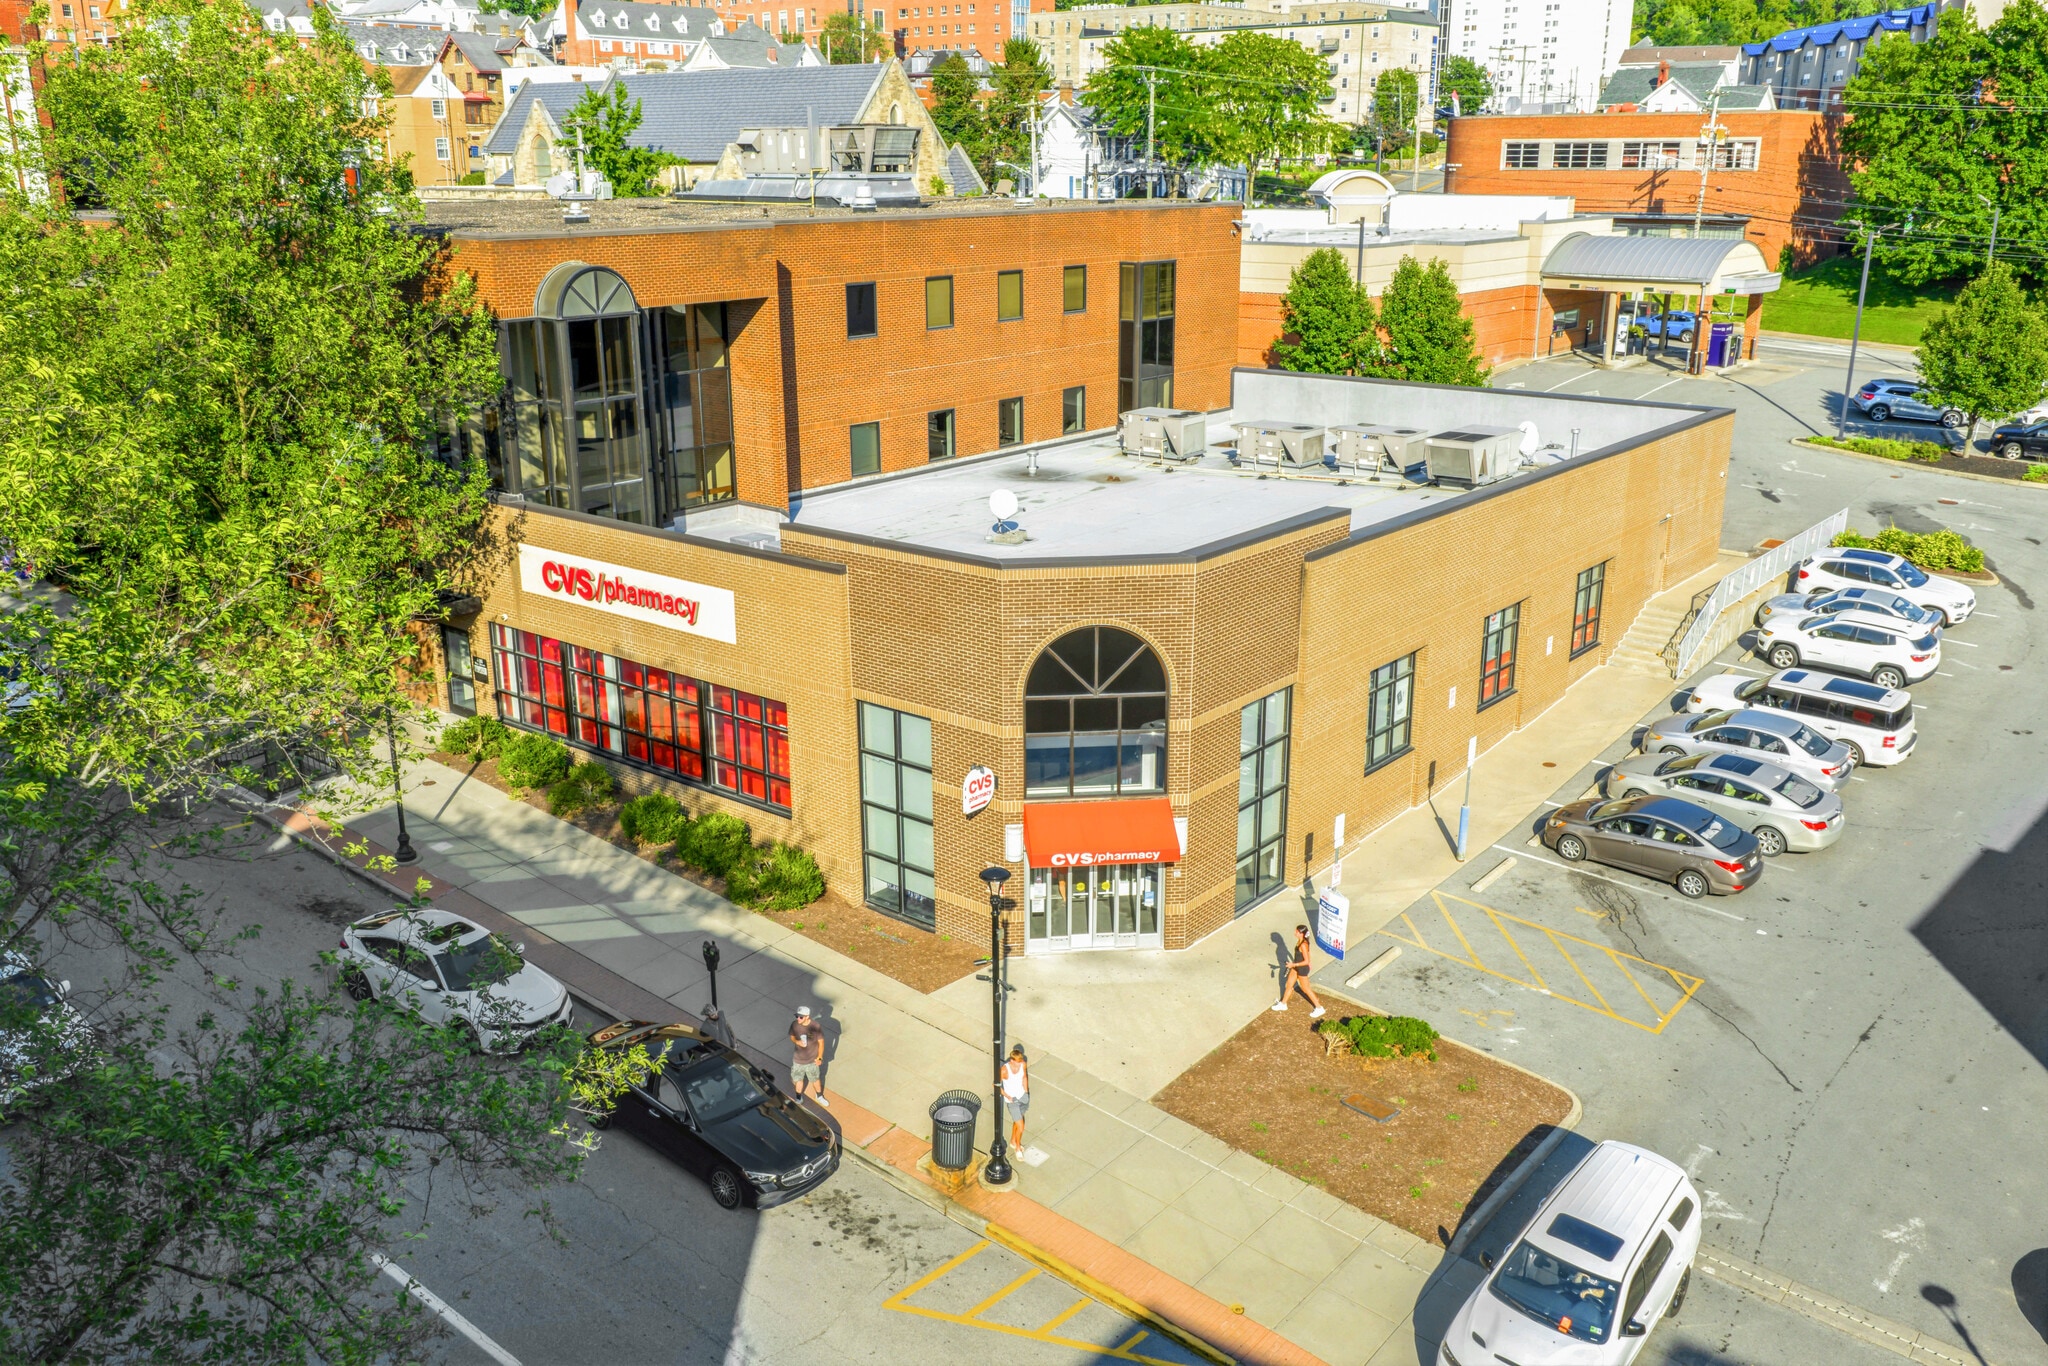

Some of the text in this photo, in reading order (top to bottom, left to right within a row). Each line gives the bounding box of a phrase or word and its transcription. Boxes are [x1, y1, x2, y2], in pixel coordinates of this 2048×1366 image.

[541, 560, 699, 625] CVS/pharmacy
[969, 774, 992, 794] CVS
[969, 790, 991, 803] pharmacy
[1050, 851, 1161, 866] CVS/pharmacy
